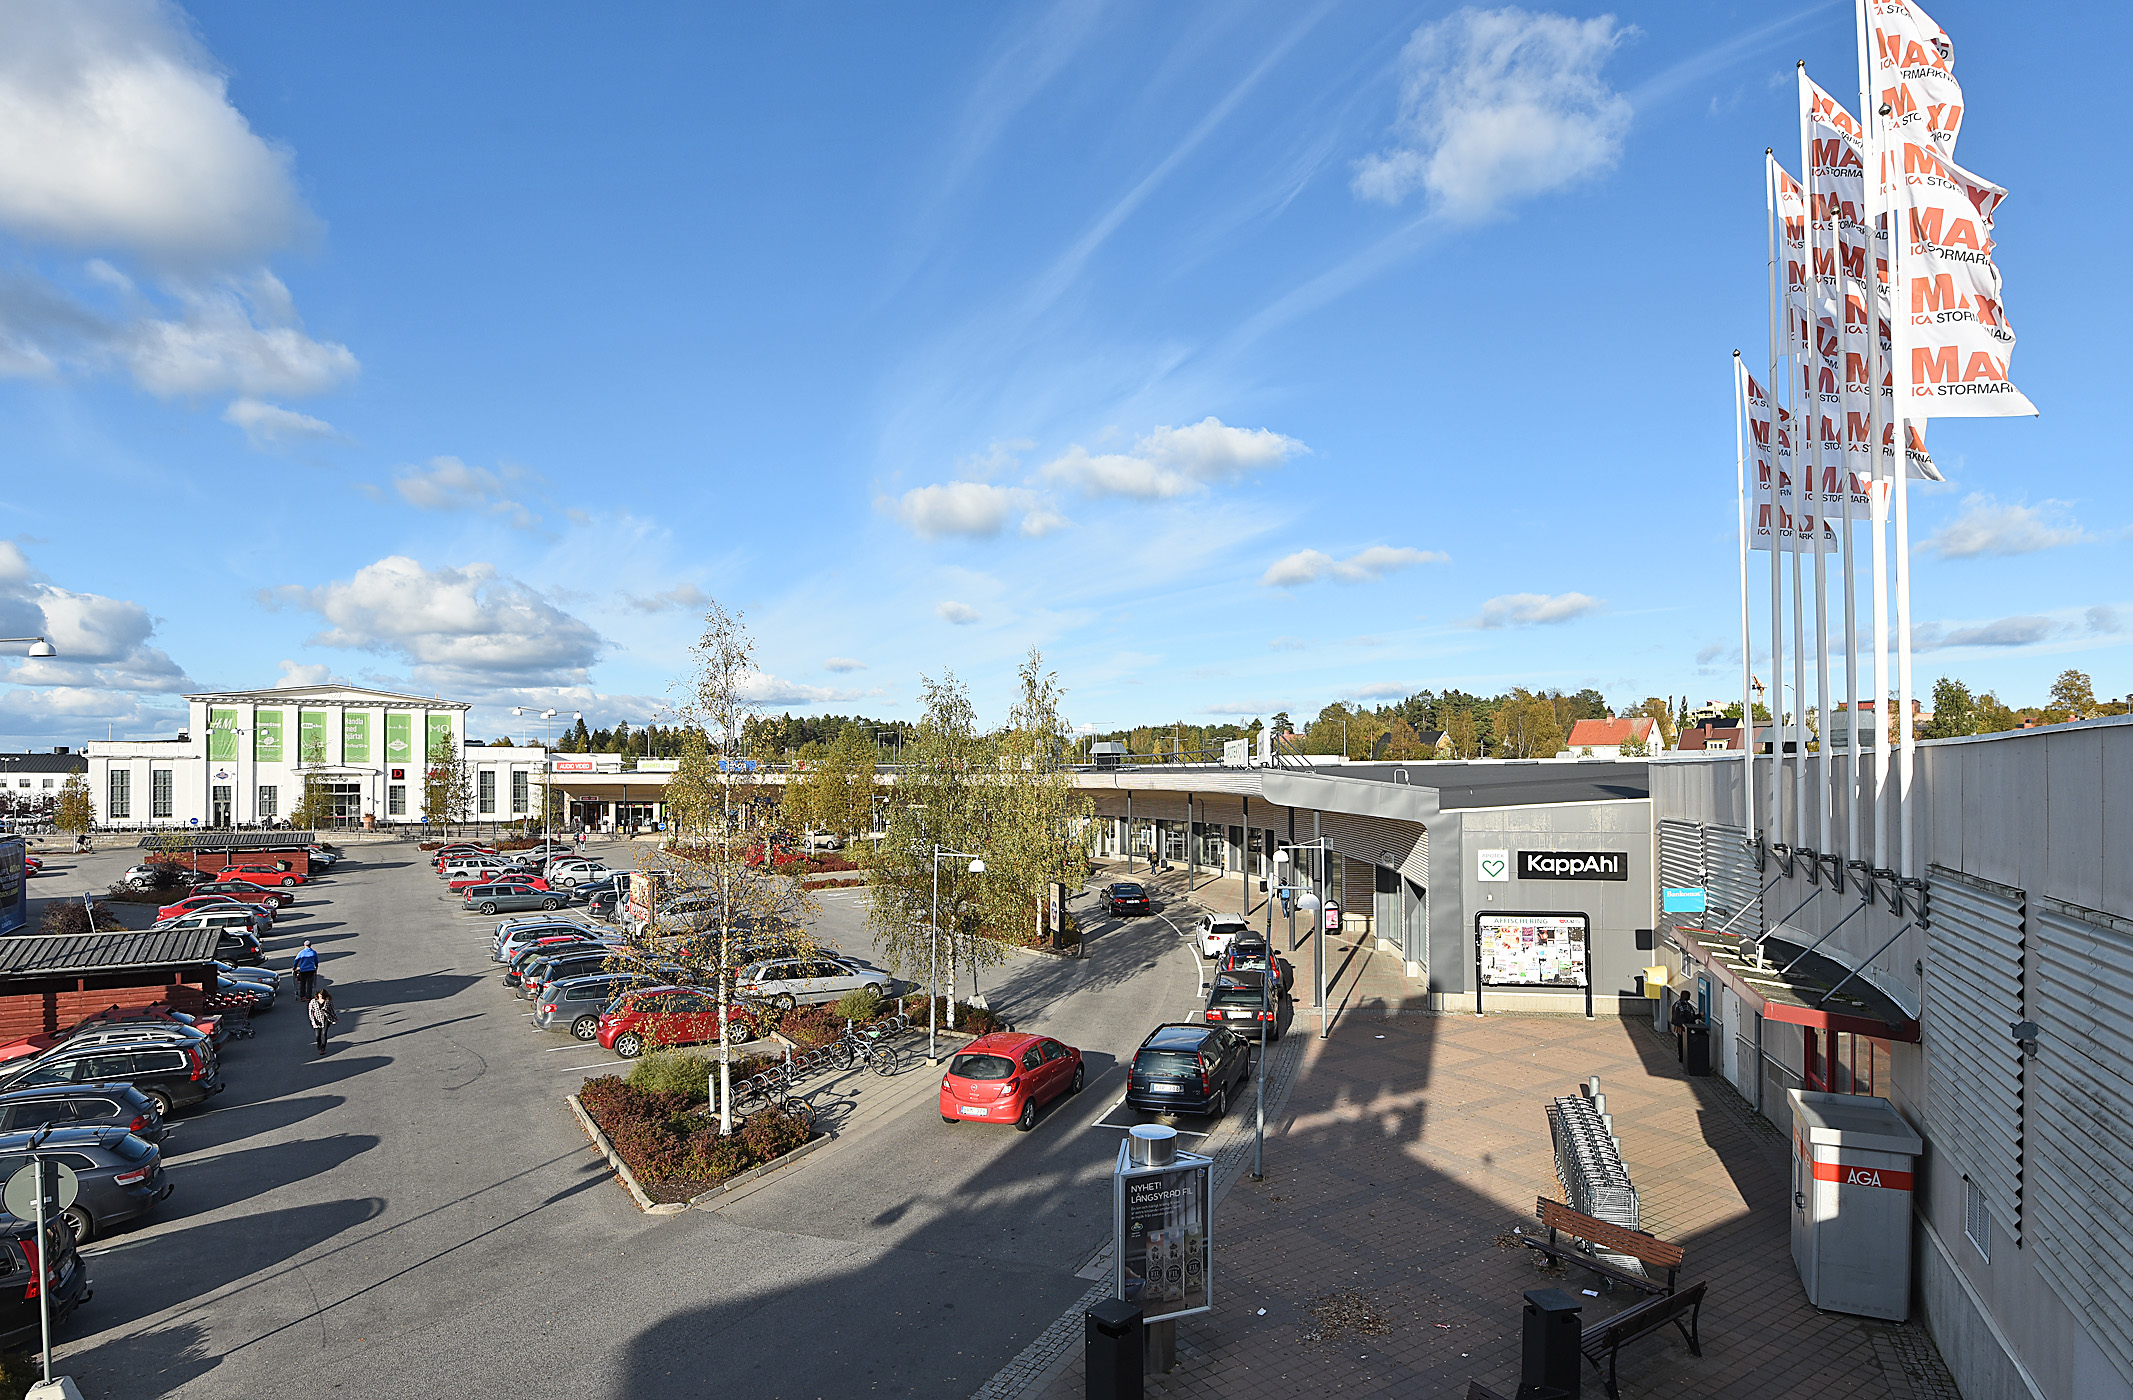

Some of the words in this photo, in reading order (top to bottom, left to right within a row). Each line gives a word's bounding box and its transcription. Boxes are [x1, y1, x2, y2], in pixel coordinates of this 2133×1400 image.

[1905, 175, 1922, 186] ICA
[1911, 315, 1932, 326] ICA
[1845, 325, 1863, 334] ICA
[1845, 384, 1863, 393] ICA
[1911, 386, 1933, 397] ICA
[1527, 855, 1618, 875] KappAhl
[1847, 1167, 1881, 1187] AGA
[1131, 1182, 1162, 1193] NYHET!
[1131, 1190, 1181, 1204] LÅNGSYRAD
[1182, 1188, 1193, 1196] FIL
